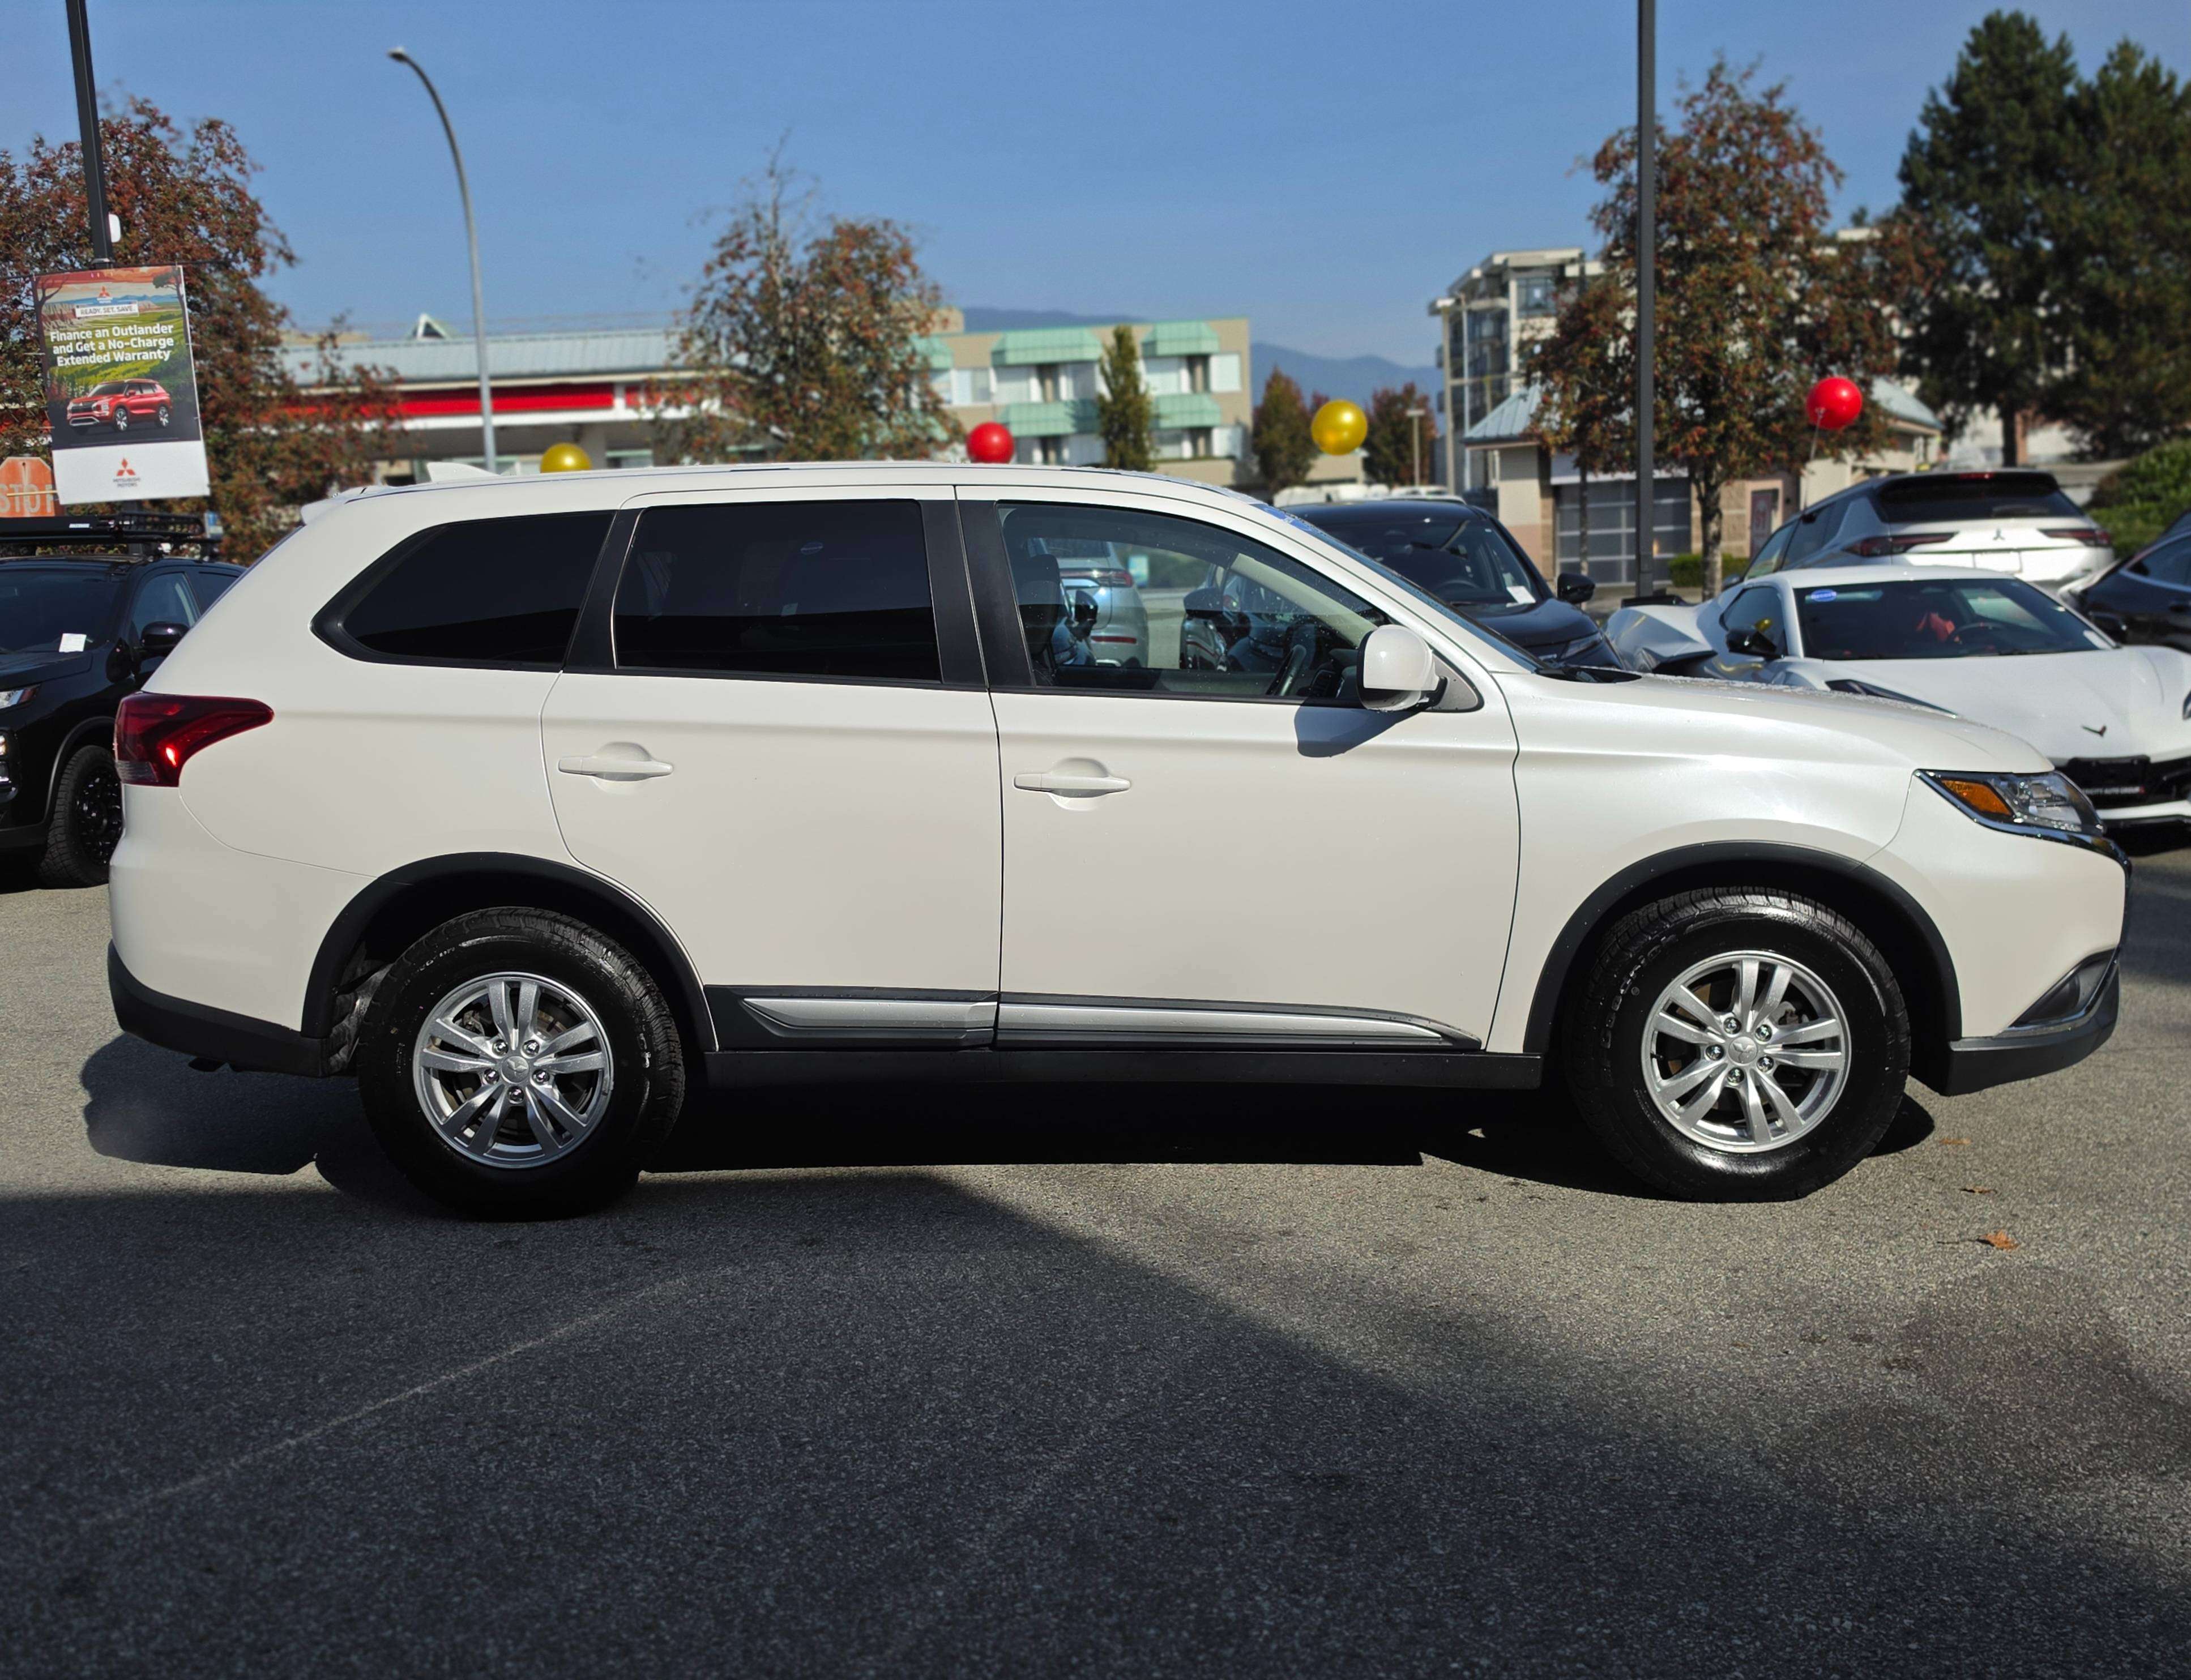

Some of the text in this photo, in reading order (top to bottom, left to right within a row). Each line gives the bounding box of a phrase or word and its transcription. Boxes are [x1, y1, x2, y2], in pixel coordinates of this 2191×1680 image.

[50, 323, 174, 342] Finance an Outlander
[53, 336, 174, 354] and Get a No-Charge
[57, 349, 171, 367] Extended Warranty
